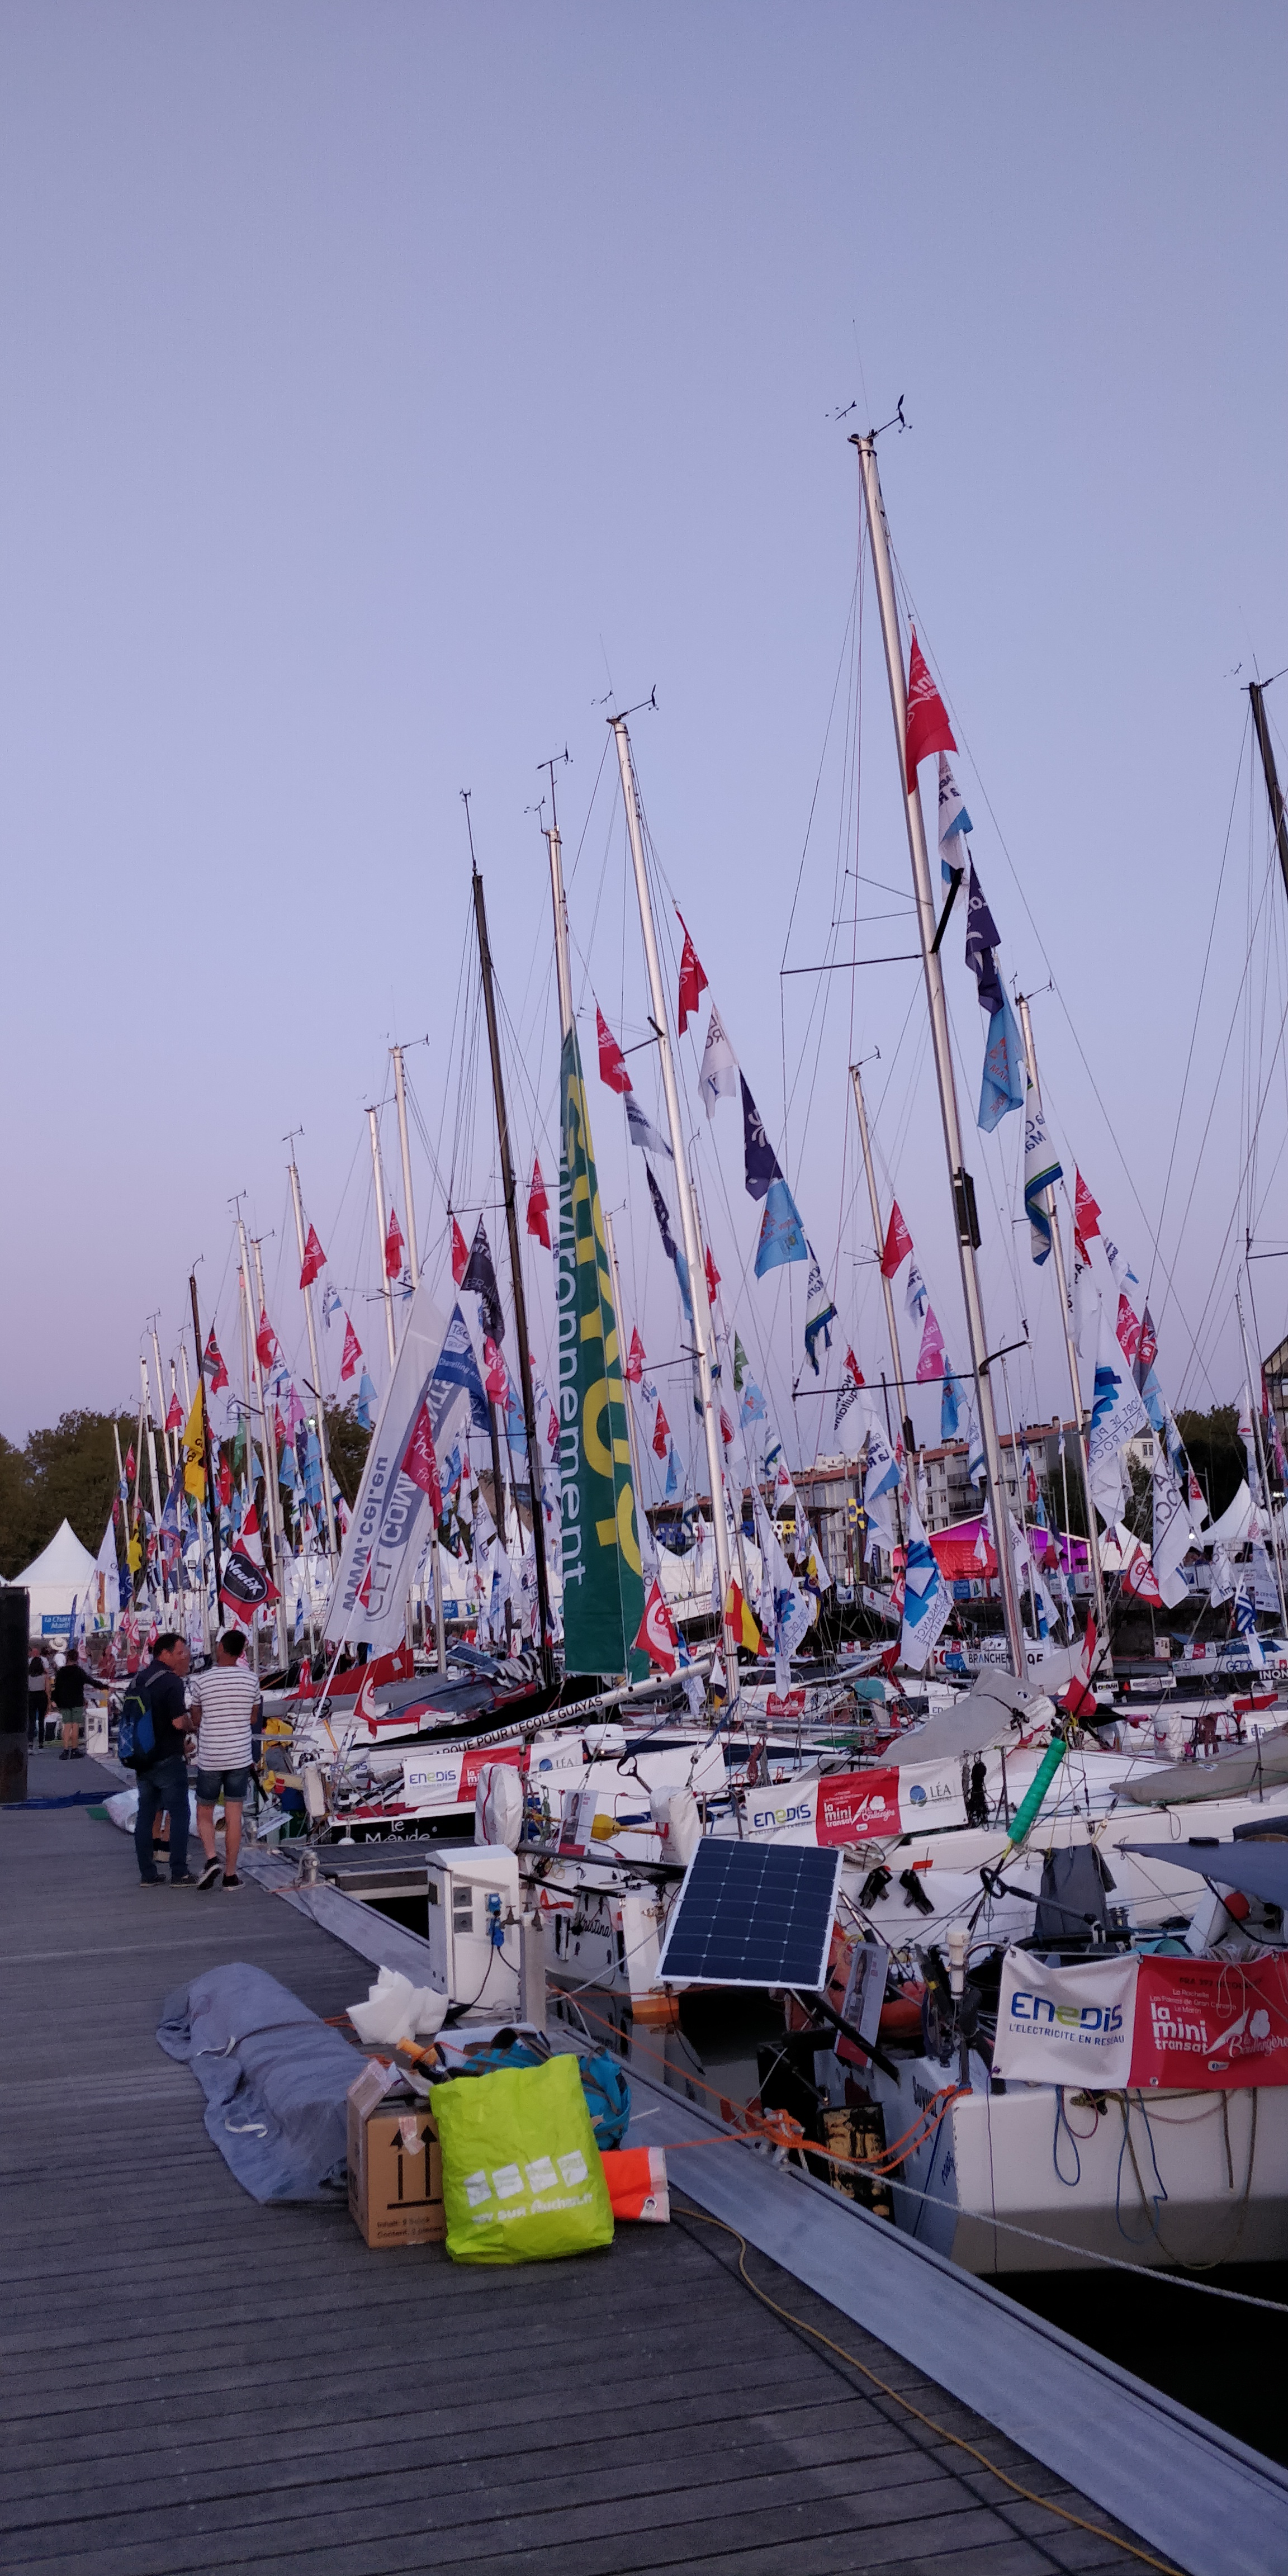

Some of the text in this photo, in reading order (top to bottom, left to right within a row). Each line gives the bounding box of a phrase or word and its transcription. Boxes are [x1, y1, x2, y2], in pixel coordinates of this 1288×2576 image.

[560, 1126, 585, 1587] nvironnement
[968, 1653, 1010, 1664] BRANCHE
[477, 1730, 508, 1748] POUR
[511, 1712, 557, 1736] L'ECOLE
[558, 1696, 604, 1719] GUAYAS
[930, 1784, 951, 1798] LÉA
[824, 1802, 834, 1812] la
[825, 1805, 852, 1822] mini
[1150, 2002, 1171, 2020] la
[1008, 2023, 1125, 2047] L'ELECTRICITE EN RESEAU
[1153, 2017, 1208, 2042] mini
[1154, 2040, 1208, 2056] transat
